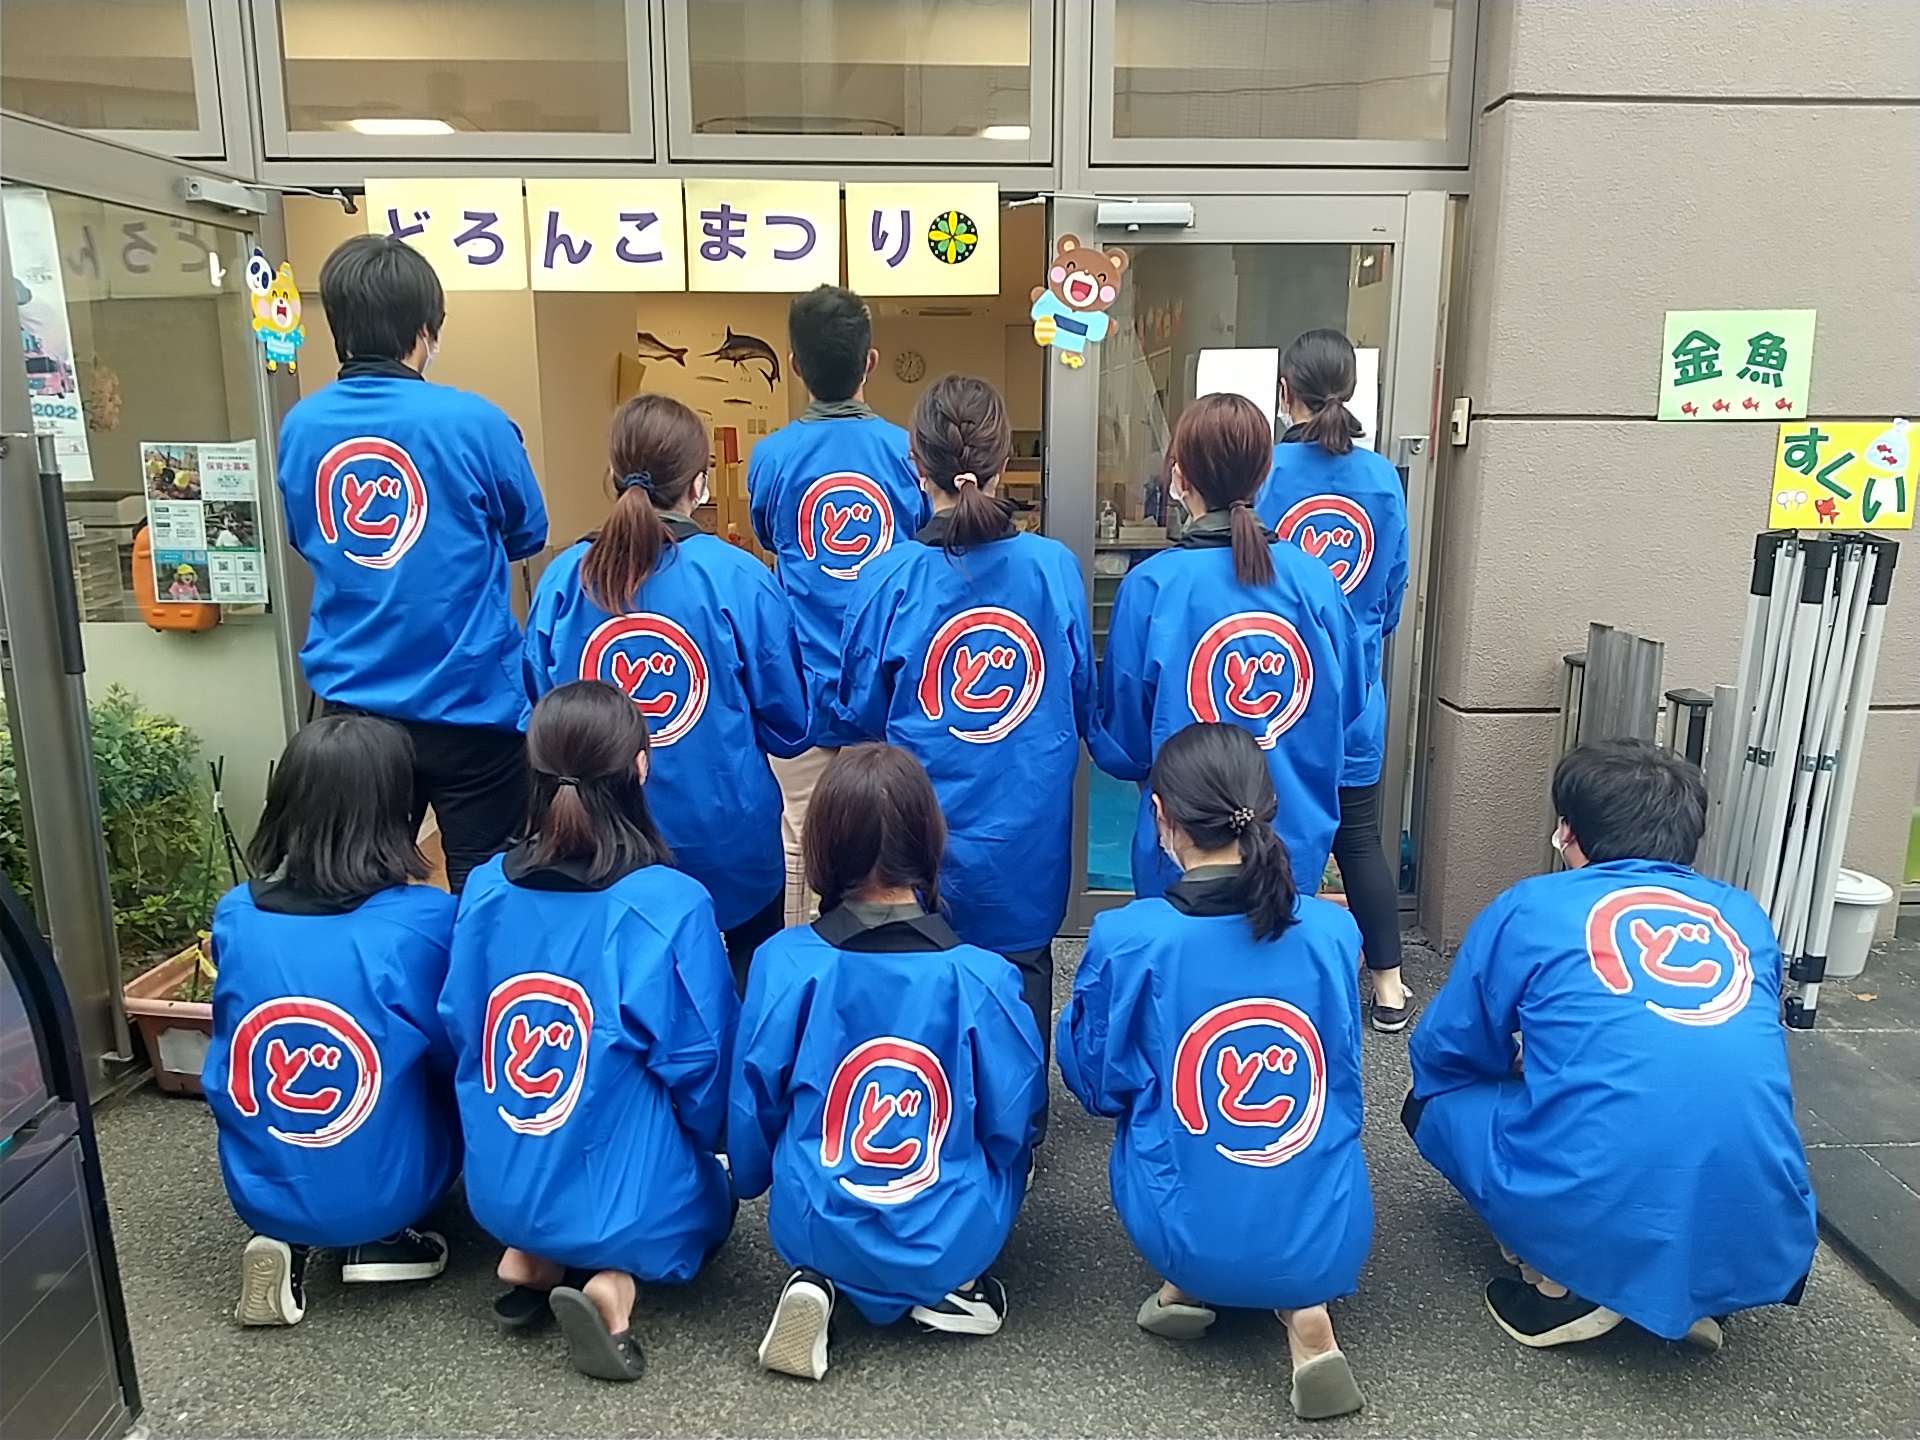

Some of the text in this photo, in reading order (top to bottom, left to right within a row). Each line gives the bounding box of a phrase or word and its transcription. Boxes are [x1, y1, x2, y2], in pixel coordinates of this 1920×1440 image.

[387, 203, 913, 269] どろんこまつり
[1671, 329, 1788, 387] 金魚
[33, 402, 78, 420] 2022
[342, 474, 400, 539] ど
[1783, 427, 1906, 523] すくい
[822, 502, 872, 556] ど
[951, 645, 1017, 713] ど
[1224, 651, 1285, 718] ど
[1630, 919, 1710, 988] ど
[267, 1038, 342, 1115] ど
[504, 1014, 575, 1099] ど
[1216, 1045, 1297, 1127] ど
[850, 1081, 922, 1171] ど
